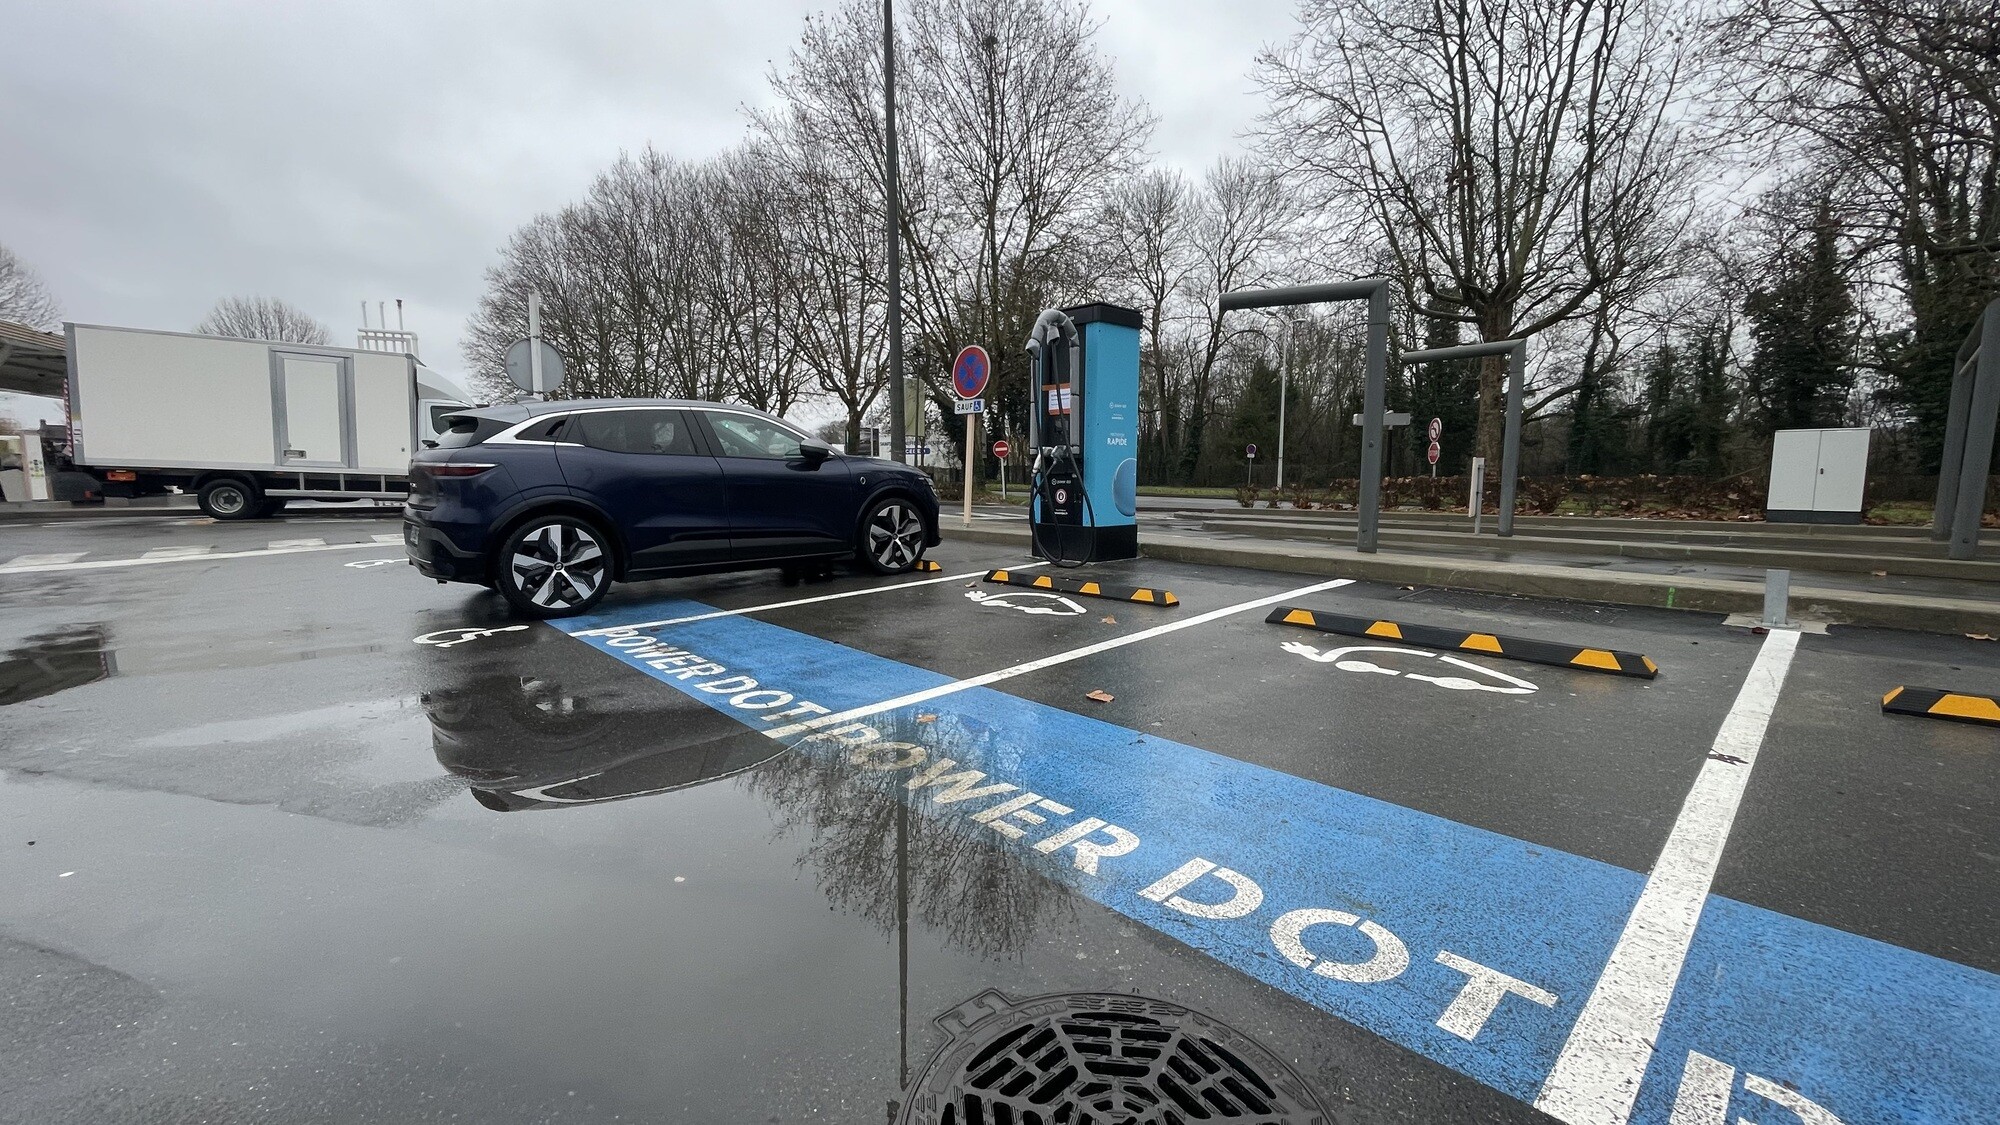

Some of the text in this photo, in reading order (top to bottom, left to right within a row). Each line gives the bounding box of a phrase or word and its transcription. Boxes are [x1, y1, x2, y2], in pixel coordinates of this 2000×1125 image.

[956, 402, 973, 411] SAUF
[1107, 438, 1127, 446] RAPIDE
[598, 628, 832, 721] POWER DOT
[803, 722, 1559, 1041] POWER DOT
